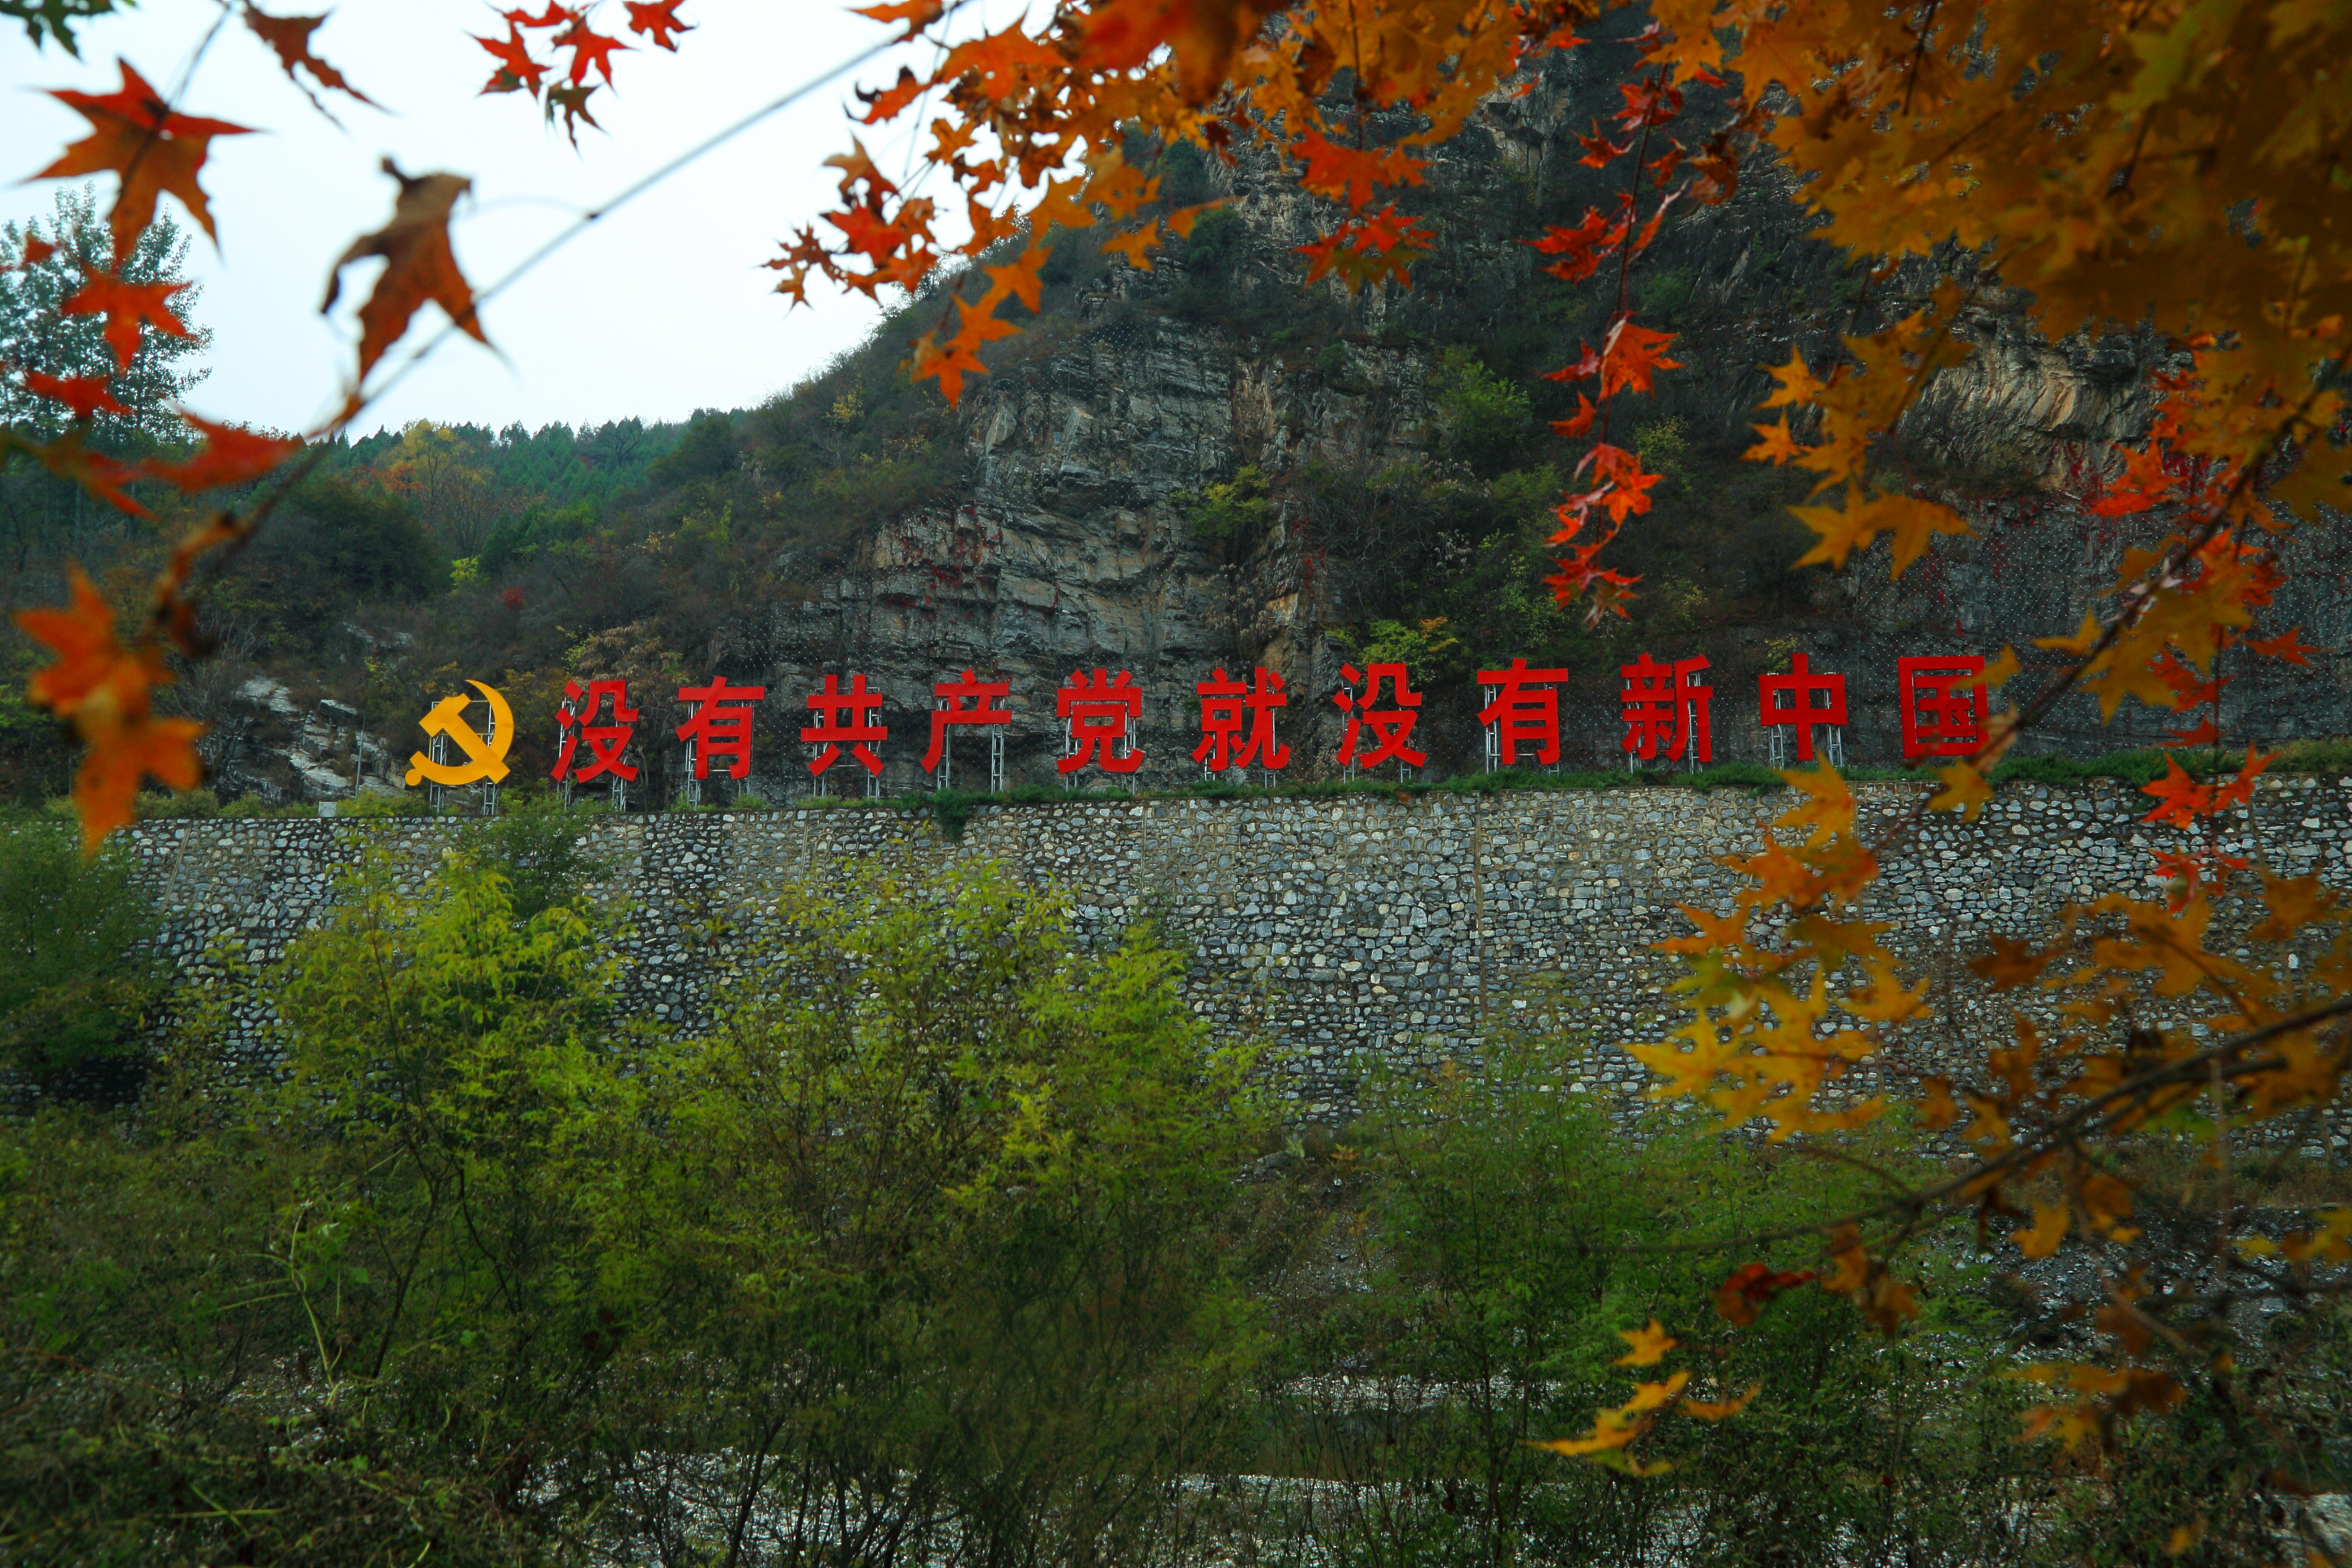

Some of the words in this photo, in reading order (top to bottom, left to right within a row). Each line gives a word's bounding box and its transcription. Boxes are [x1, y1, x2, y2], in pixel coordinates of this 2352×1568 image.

[550, 652, 1990, 784] 没有共产党就没有新中国
